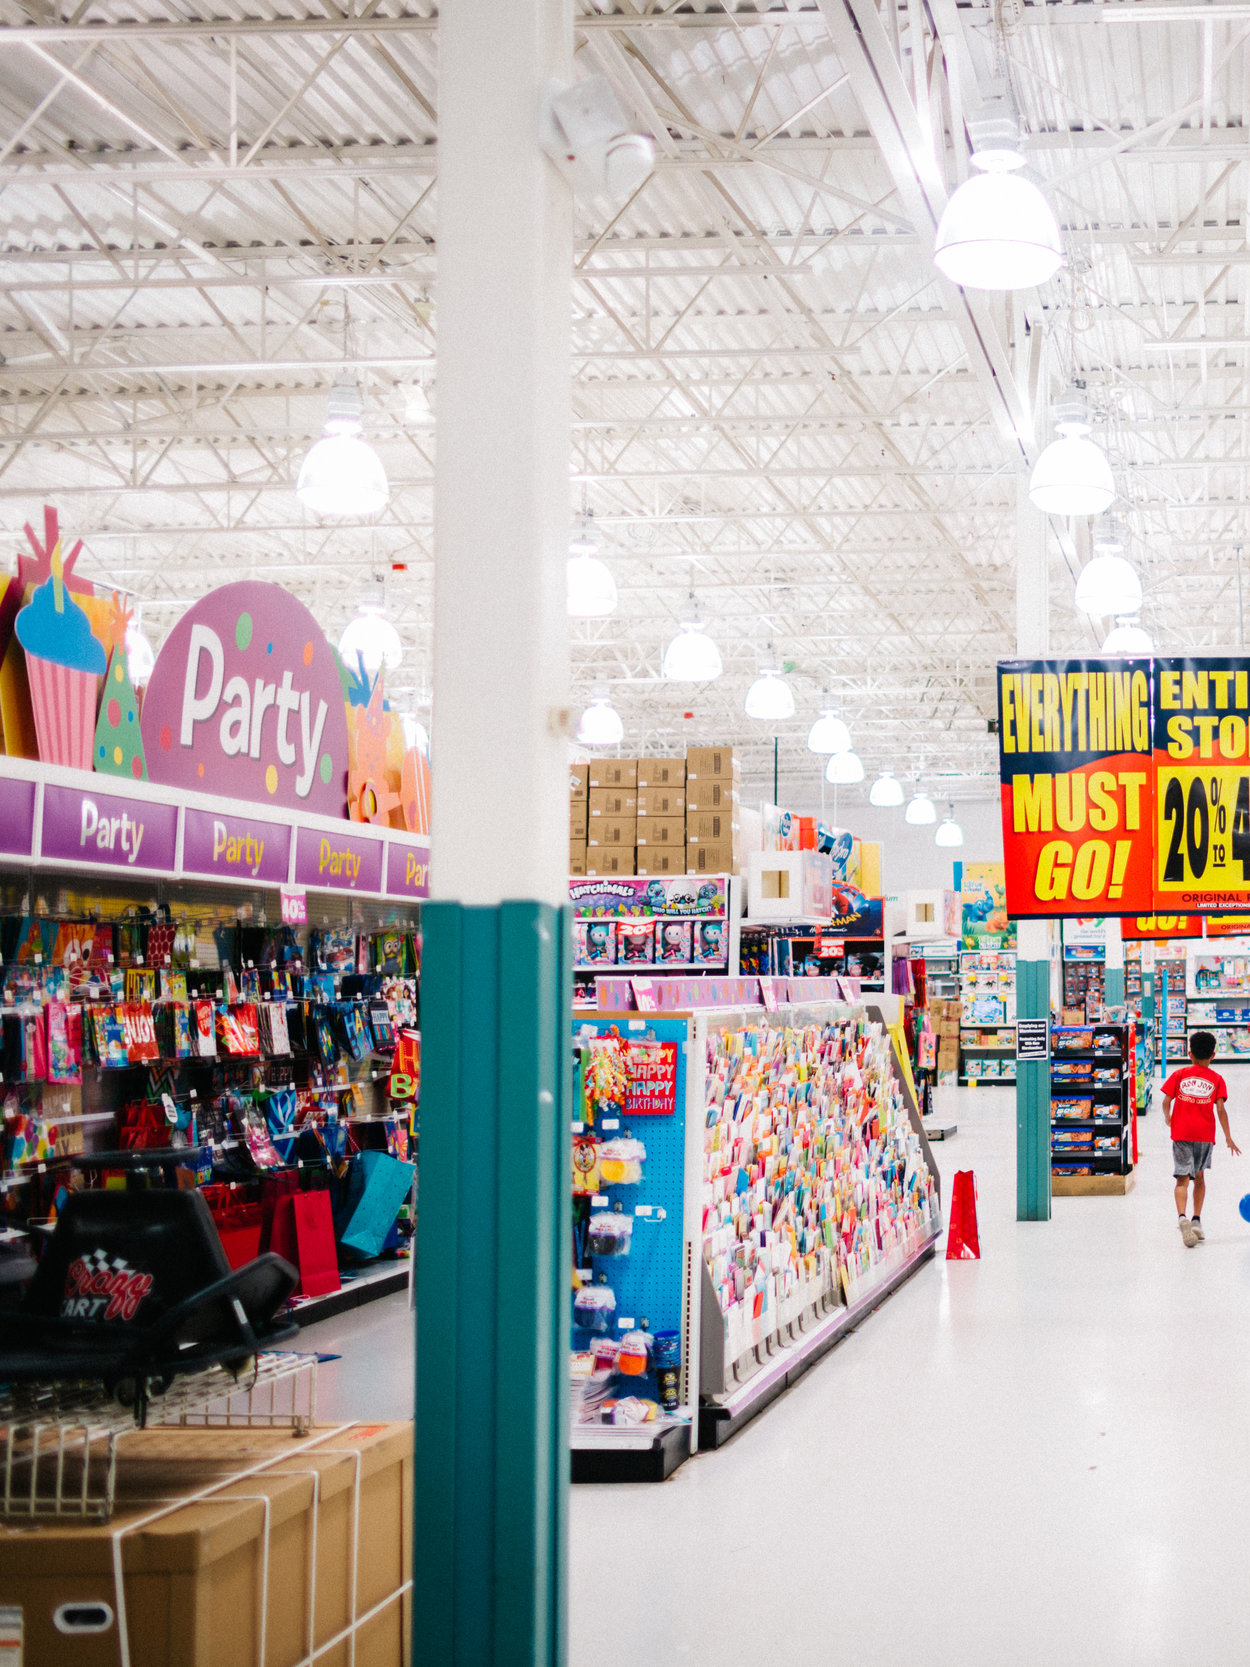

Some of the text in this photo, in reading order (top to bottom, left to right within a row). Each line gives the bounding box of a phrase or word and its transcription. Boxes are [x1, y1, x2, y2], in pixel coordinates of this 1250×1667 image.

[180, 623, 328, 797] Party
[1000, 670, 1149, 754] EVERYTHING
[1012, 771, 1146, 833] MUST
[80, 799, 145, 864] Party
[213, 820, 264, 876] Party
[319, 837, 361, 887] Party
[406, 853, 430, 888] Par
[1034, 840, 1132, 902] GO!
[652, 906, 666, 914] WHO
[691, 905, 712, 914] HATCH?
[1182, 893, 1242, 903] ORIGINAL
[626, 1081, 674, 1096] HAPPY
[626, 1097, 674, 1111] BIRTHDAY
[1182, 1080, 1212, 1090] RON JON
[60, 1298, 109, 1318] ART
[65, 1258, 154, 1321] Crazy
